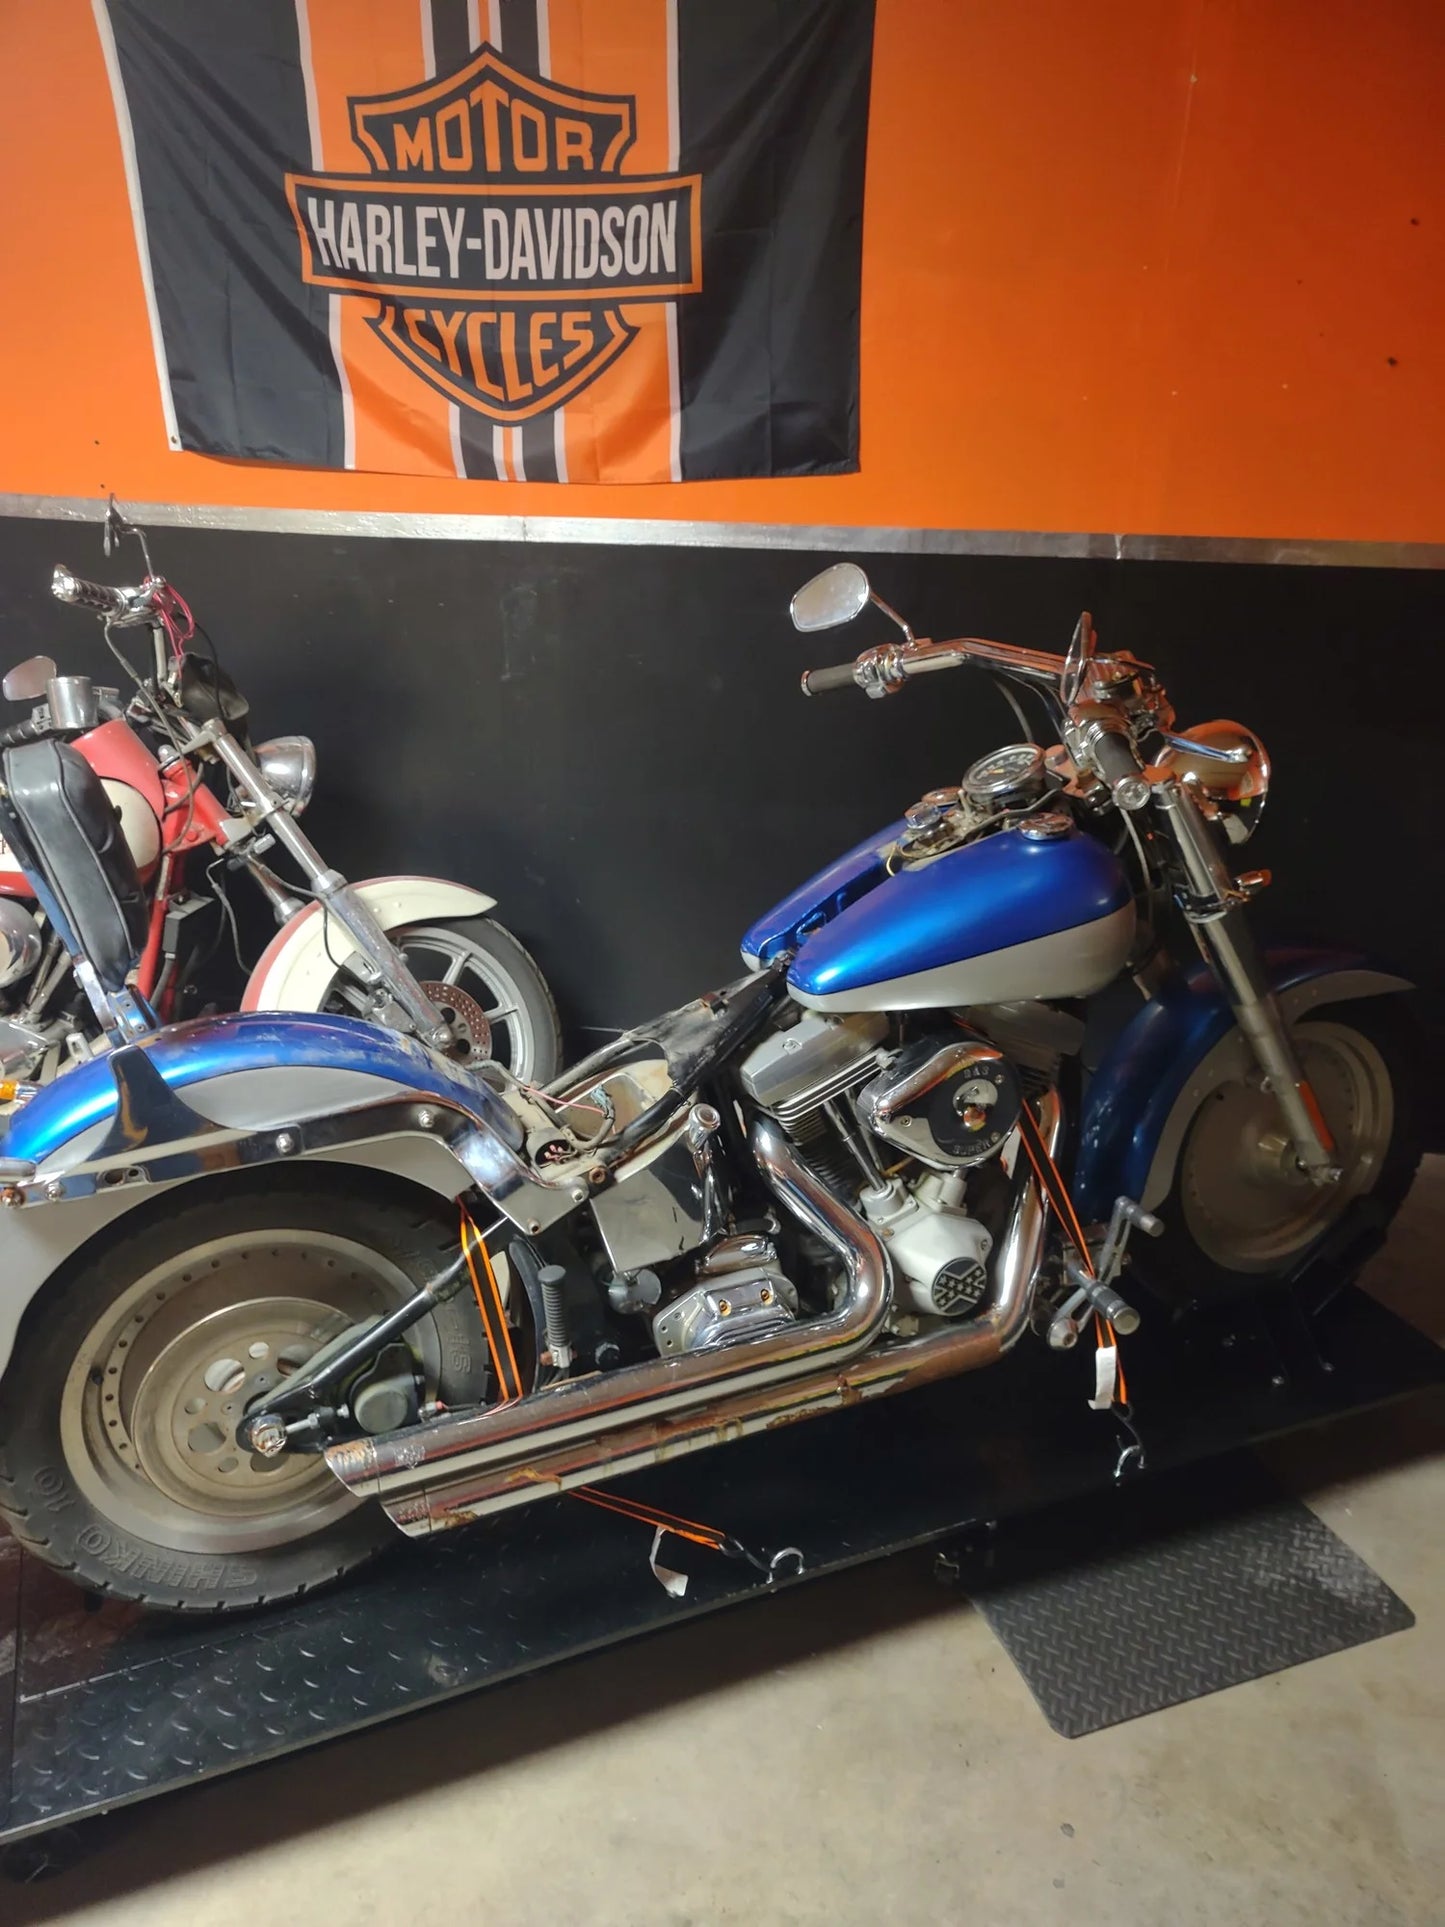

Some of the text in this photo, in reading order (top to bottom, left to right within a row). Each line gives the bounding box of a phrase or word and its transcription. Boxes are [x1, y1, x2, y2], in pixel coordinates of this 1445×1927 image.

[393, 79, 594, 173] MOTOR
[307, 196, 678, 280] HARLEY-DAVIDSON
[403, 308, 594, 402] CYCLES
[76, 1523, 259, 1590] SHINKO
